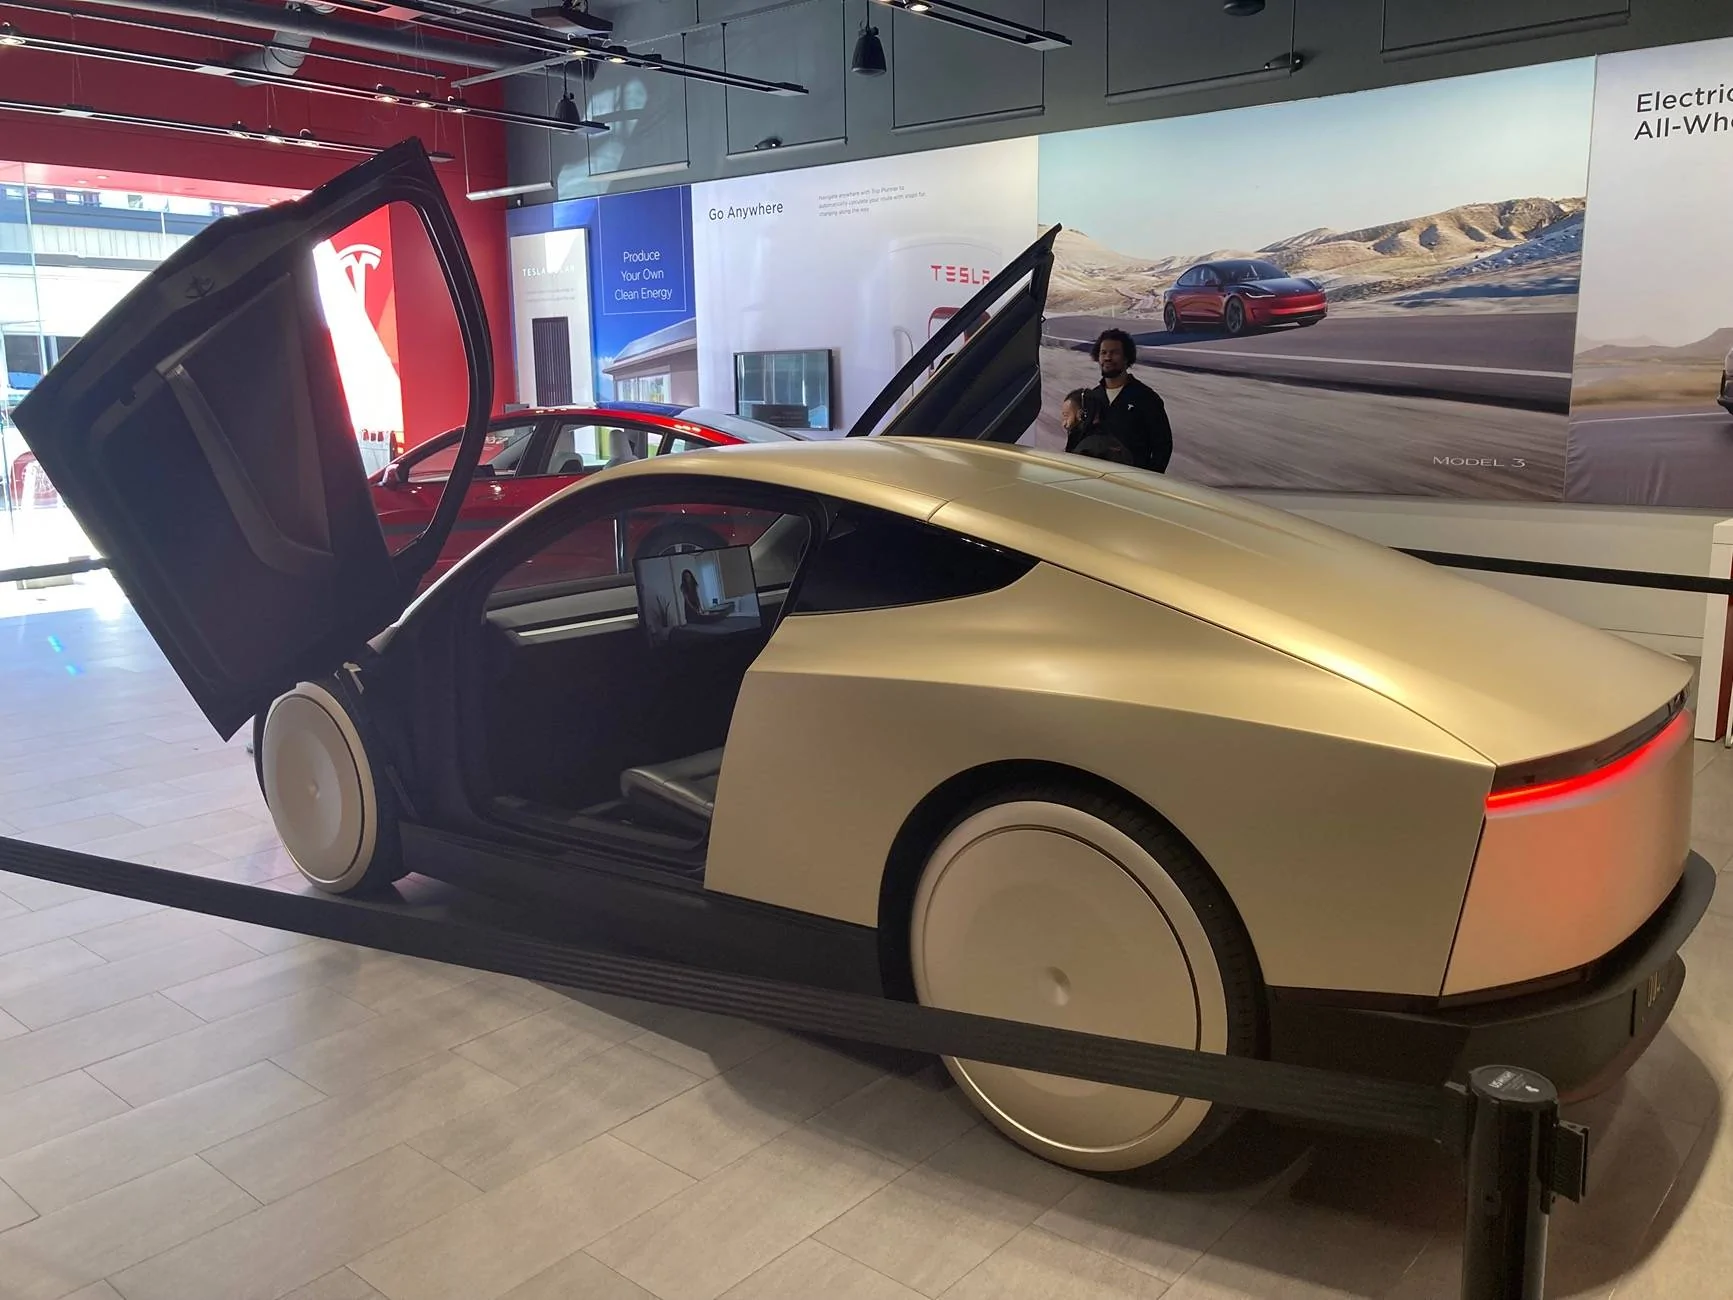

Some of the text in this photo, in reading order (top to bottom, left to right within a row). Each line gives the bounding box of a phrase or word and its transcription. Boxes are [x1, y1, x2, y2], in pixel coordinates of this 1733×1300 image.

[1634, 112, 1733, 140] All-Wh
[708, 202, 784, 221] Go Anywhere
[623, 250, 661, 263] Produce
[522, 267, 546, 277] TESLA
[621, 268, 664, 282] Your Own
[930, 265, 990, 285] TESLA
[614, 287, 672, 301] Clean Energy
[1433, 456, 1526, 468] MODEL 3
